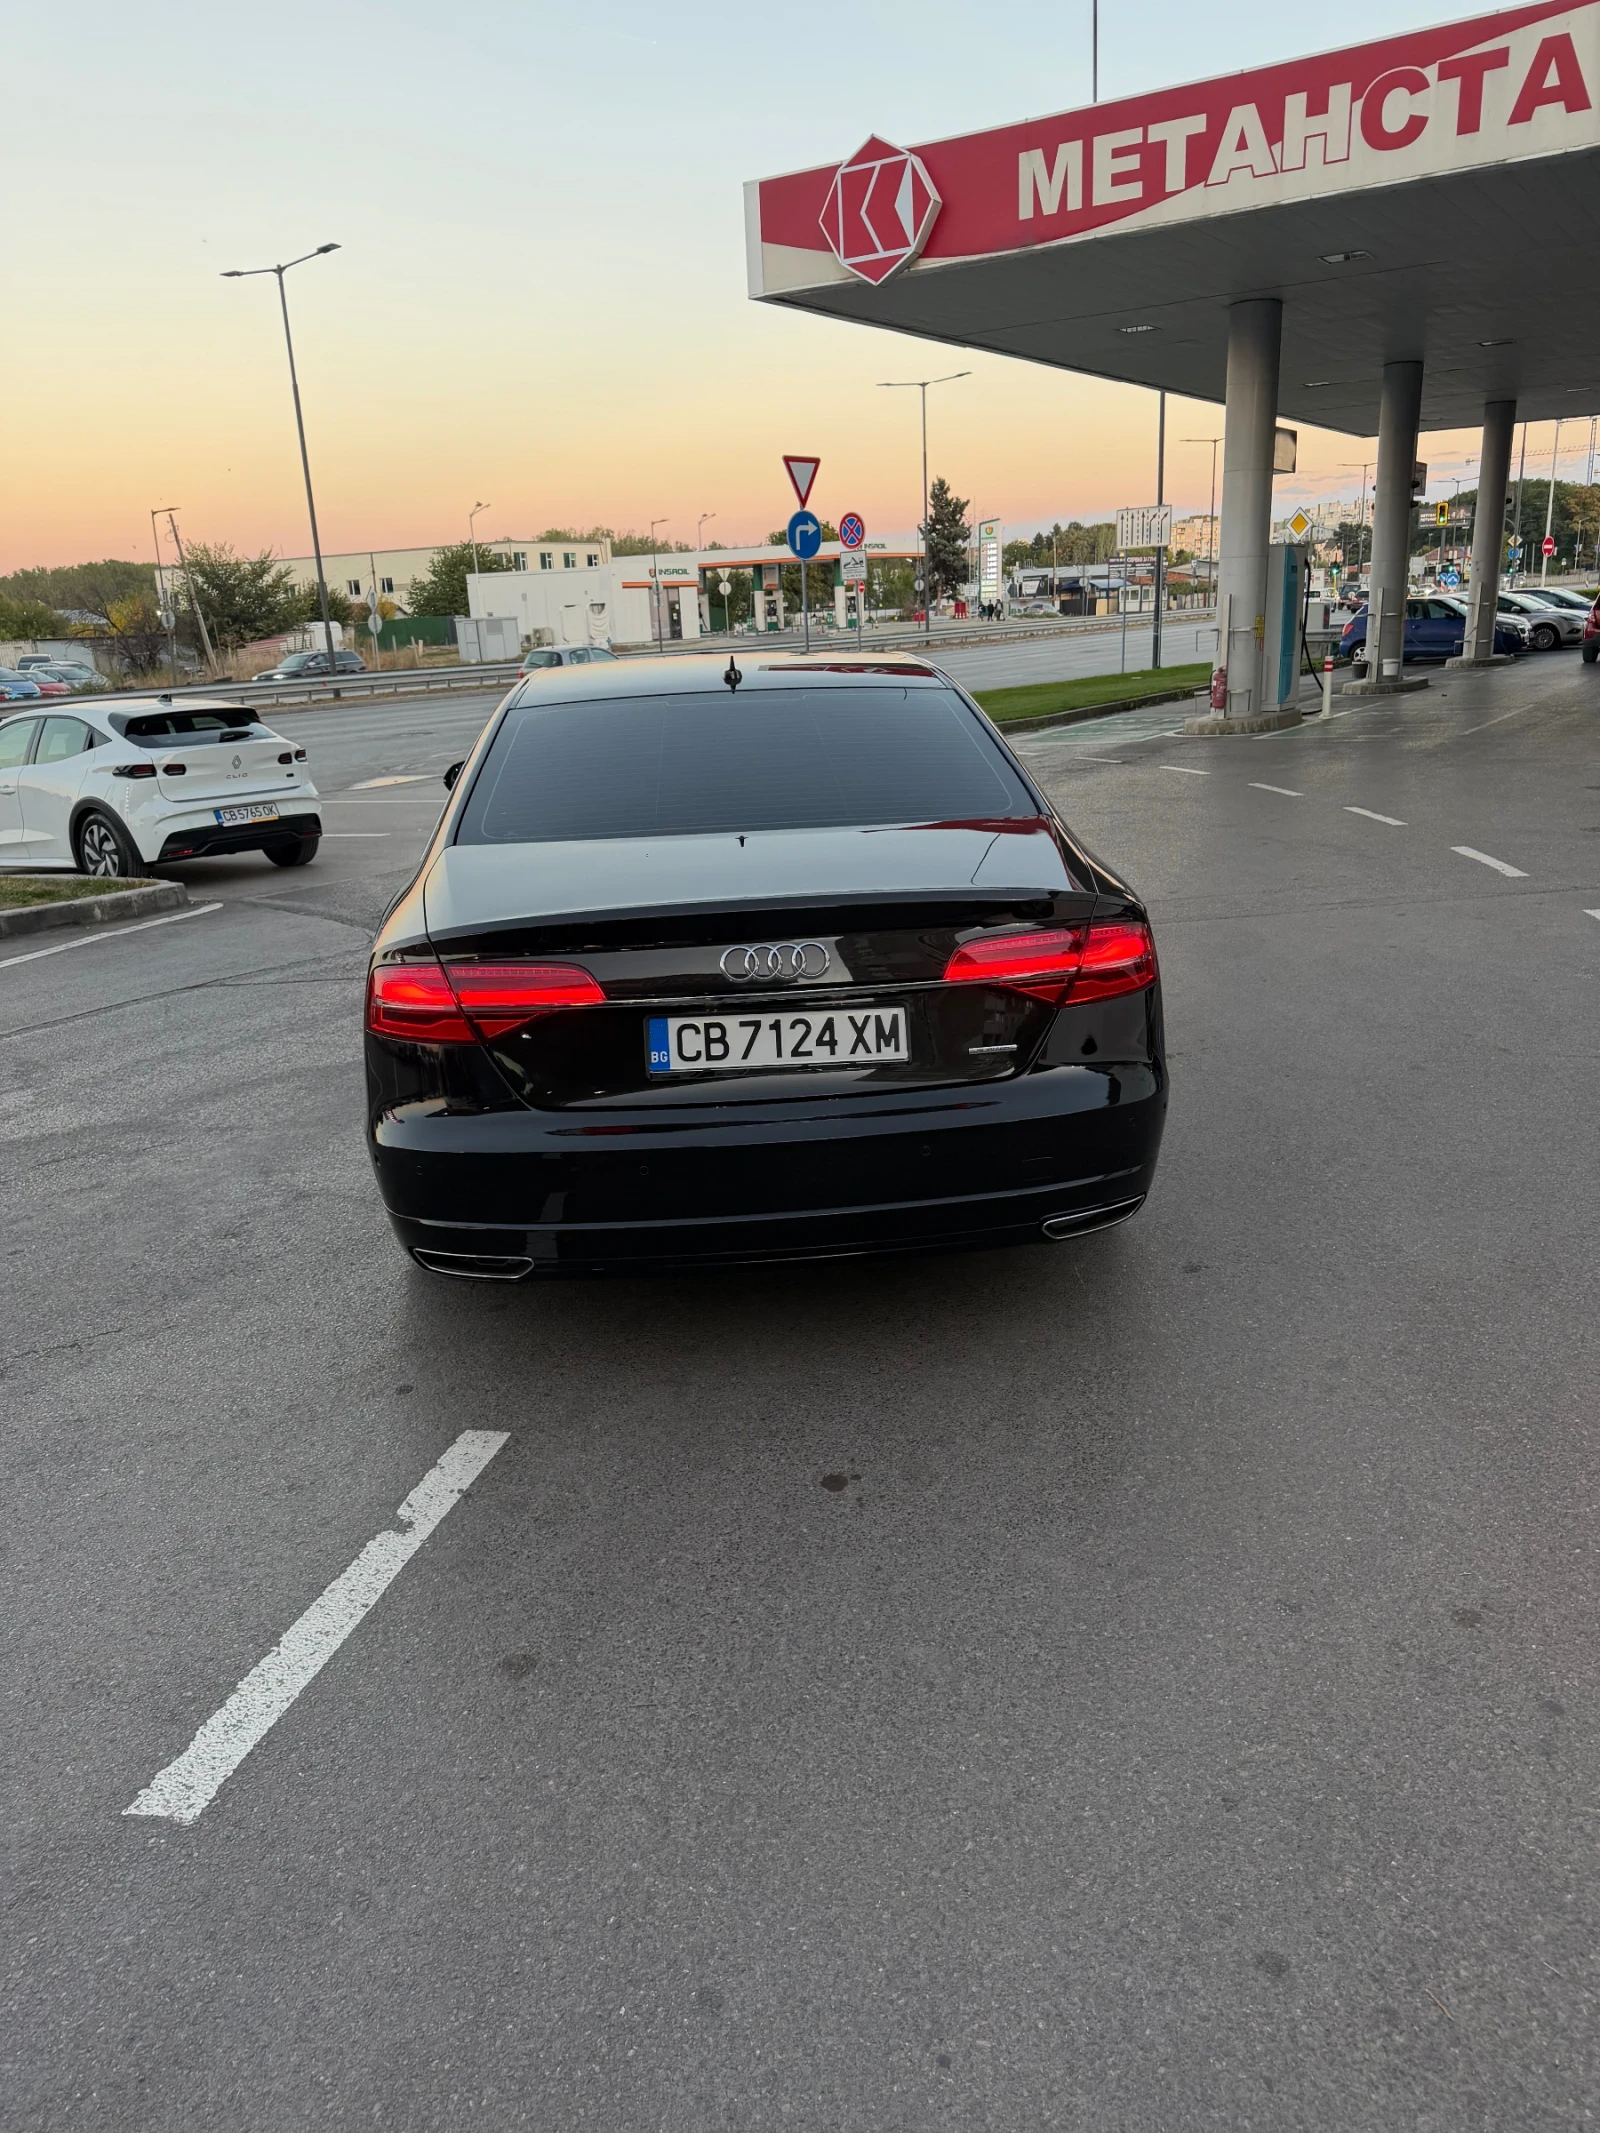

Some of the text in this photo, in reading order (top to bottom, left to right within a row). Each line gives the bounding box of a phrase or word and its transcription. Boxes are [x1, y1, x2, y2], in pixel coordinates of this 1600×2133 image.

[1018, 31, 1593, 220] МЕТАНСТА
[238, 807, 262, 820] 5765
[676, 1013, 900, 1062] CB 7124 XM
[651, 1051, 668, 1063] BG
